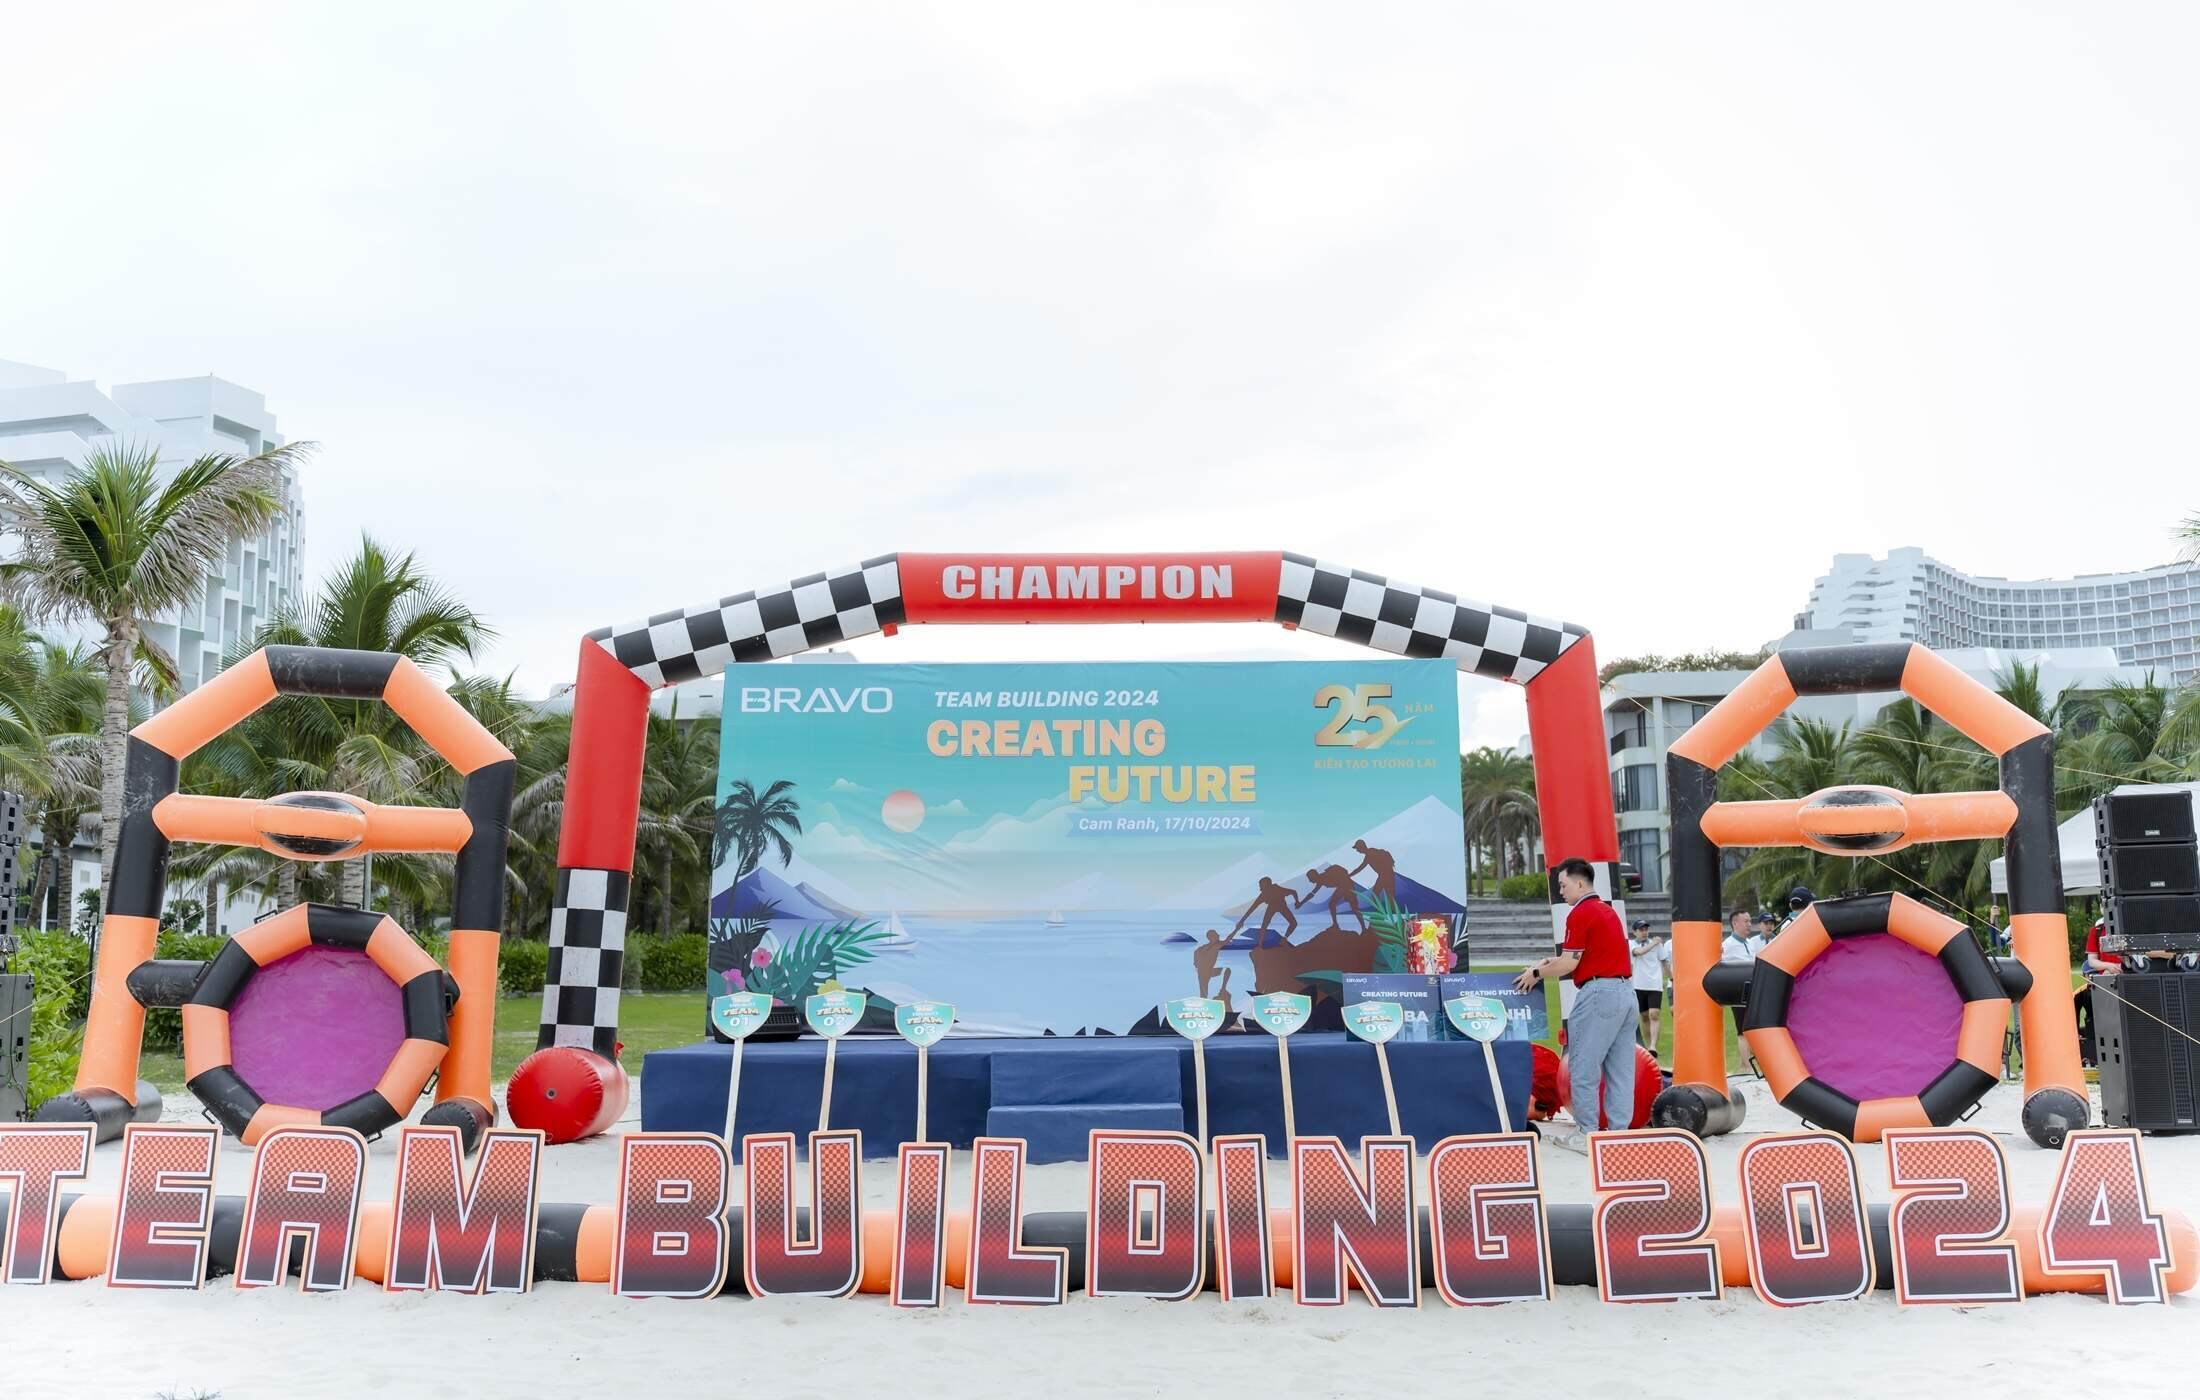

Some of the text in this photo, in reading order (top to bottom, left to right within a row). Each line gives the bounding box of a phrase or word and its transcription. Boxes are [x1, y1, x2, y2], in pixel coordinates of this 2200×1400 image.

[942, 565, 1232, 600] CHAMPION
[740, 687, 893, 713] BRAVO
[934, 690, 1159, 708] TEAM BUILDING 2024
[1312, 683, 1396, 749] 25
[926, 719, 1166, 757] CREATING
[1069, 765, 1257, 803] FUTURE
[1079, 816, 1251, 833] Cam Ranh, 17/10/2024
[722, 1008, 760, 1017] TEAM
[816, 1008, 854, 1017] TEAM
[1177, 1011, 1215, 1020] TEAM
[1263, 1007, 1301, 1016] TEAM
[1404, 1010, 1430, 1023] BA
[1460, 1011, 1497, 1020] TEAM
[730, 1017, 749, 1026] 01
[824, 1016, 845, 1026] 02
[905, 1016, 944, 1025] TEAM
[1186, 1020, 1208, 1029] 04
[1271, 1015, 1294, 1025] 05
[1356, 1016, 1393, 1024] TEAM
[1471, 1020, 1491, 1030] 07
[914, 1025, 937, 1035] 03
[1365, 1024, 1388, 1033] 06
[0, 1122, 2176, 1308] TEAM BUILDING 2024
